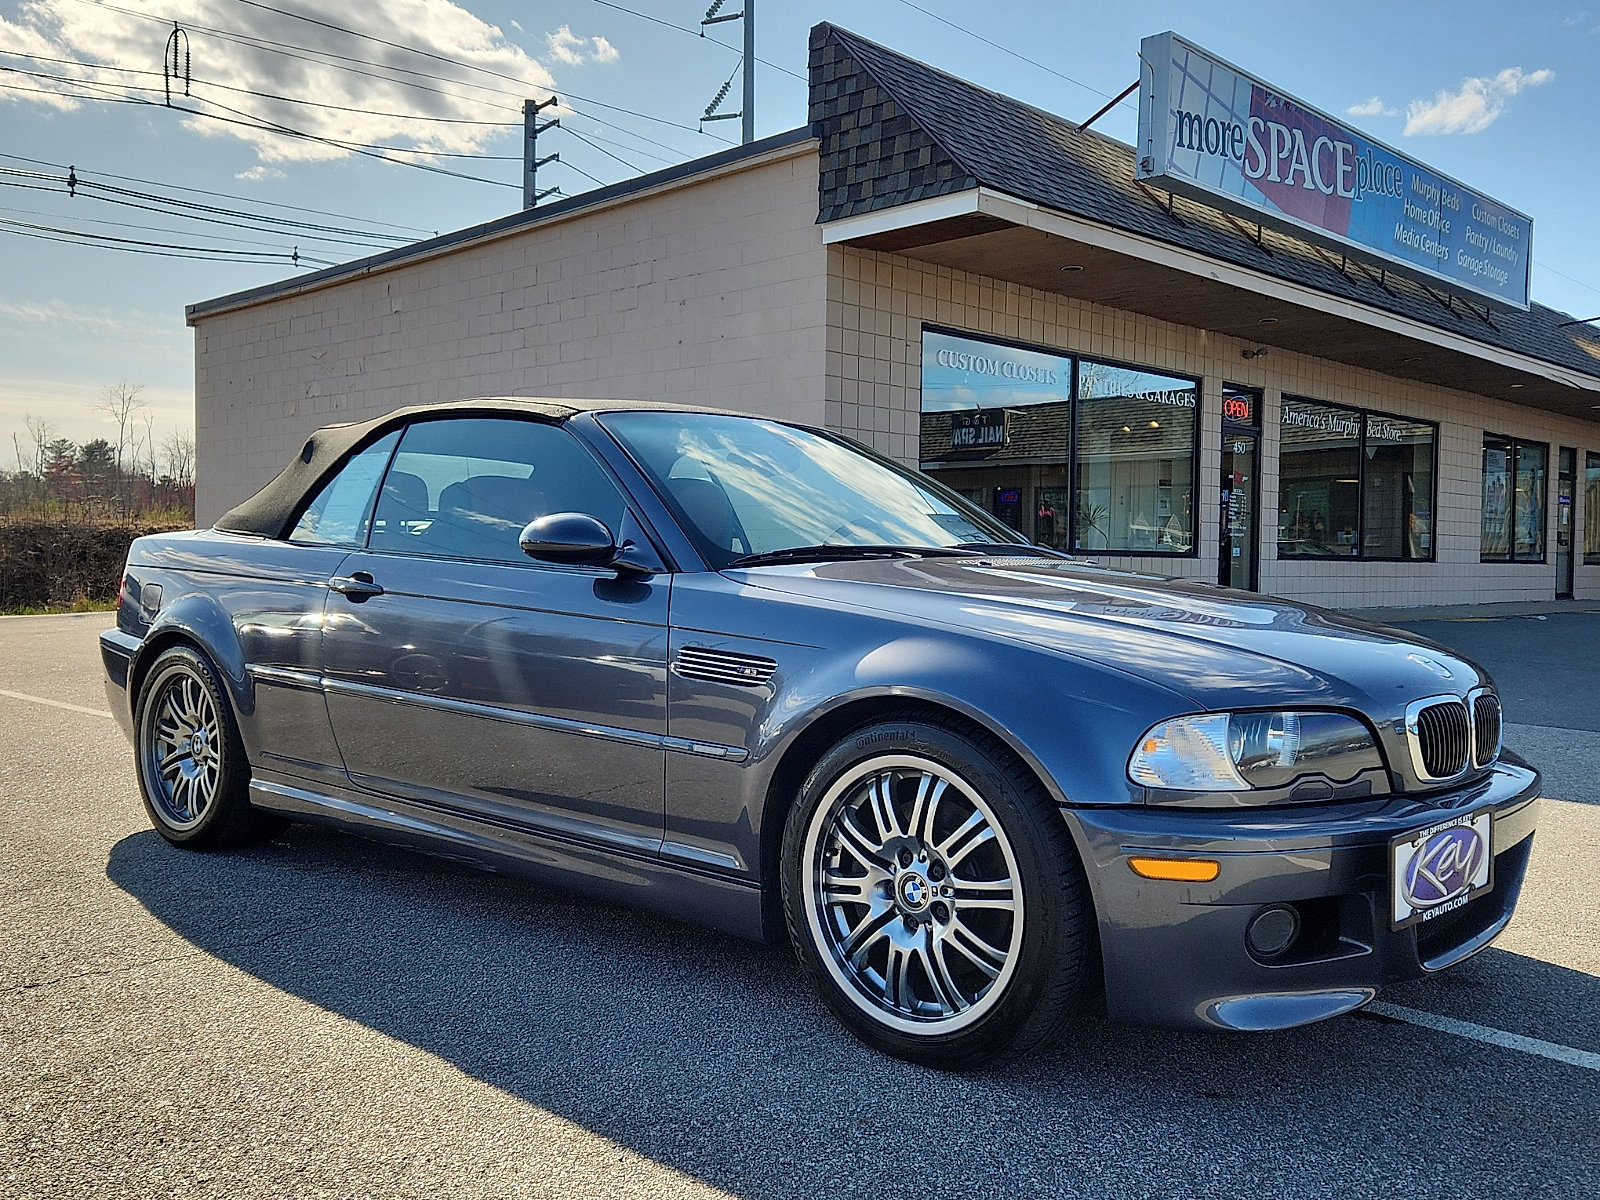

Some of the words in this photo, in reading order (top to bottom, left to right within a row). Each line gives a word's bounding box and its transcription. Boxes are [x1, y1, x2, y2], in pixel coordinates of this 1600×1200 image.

[1411, 173, 1440, 206] Murphy
[1441, 188, 1460, 211] Beds
[1403, 197, 1427, 223] Home
[1427, 208, 1451, 233] Office
[1472, 203, 1497, 230] Custom
[1497, 216, 1520, 239] Closets
[1393, 222, 1419, 249] Media
[1420, 233, 1449, 260] Centers
[1465, 226, 1489, 254] Pantry
[1493, 237, 1519, 268] Laundry
[1457, 249, 1483, 276] Garage
[1483, 260, 1509, 286] Storage
[937, 349, 999, 376] CUSTOM
[1001, 361, 1059, 385] CLOSETS
[1146, 390, 1196, 408] GARAGES
[1225, 399, 1249, 418] OPEN
[1281, 406, 1326, 430] America's
[1366, 420, 1381, 438] Bed
[1233, 442, 1246, 454] 450
[1419, 828, 1430, 839] THE
[1430, 818, 1458, 836] DIFFERENCE
[1410, 834, 1479, 898] Key
[1422, 894, 1469, 921] KEYAUTO.COM
